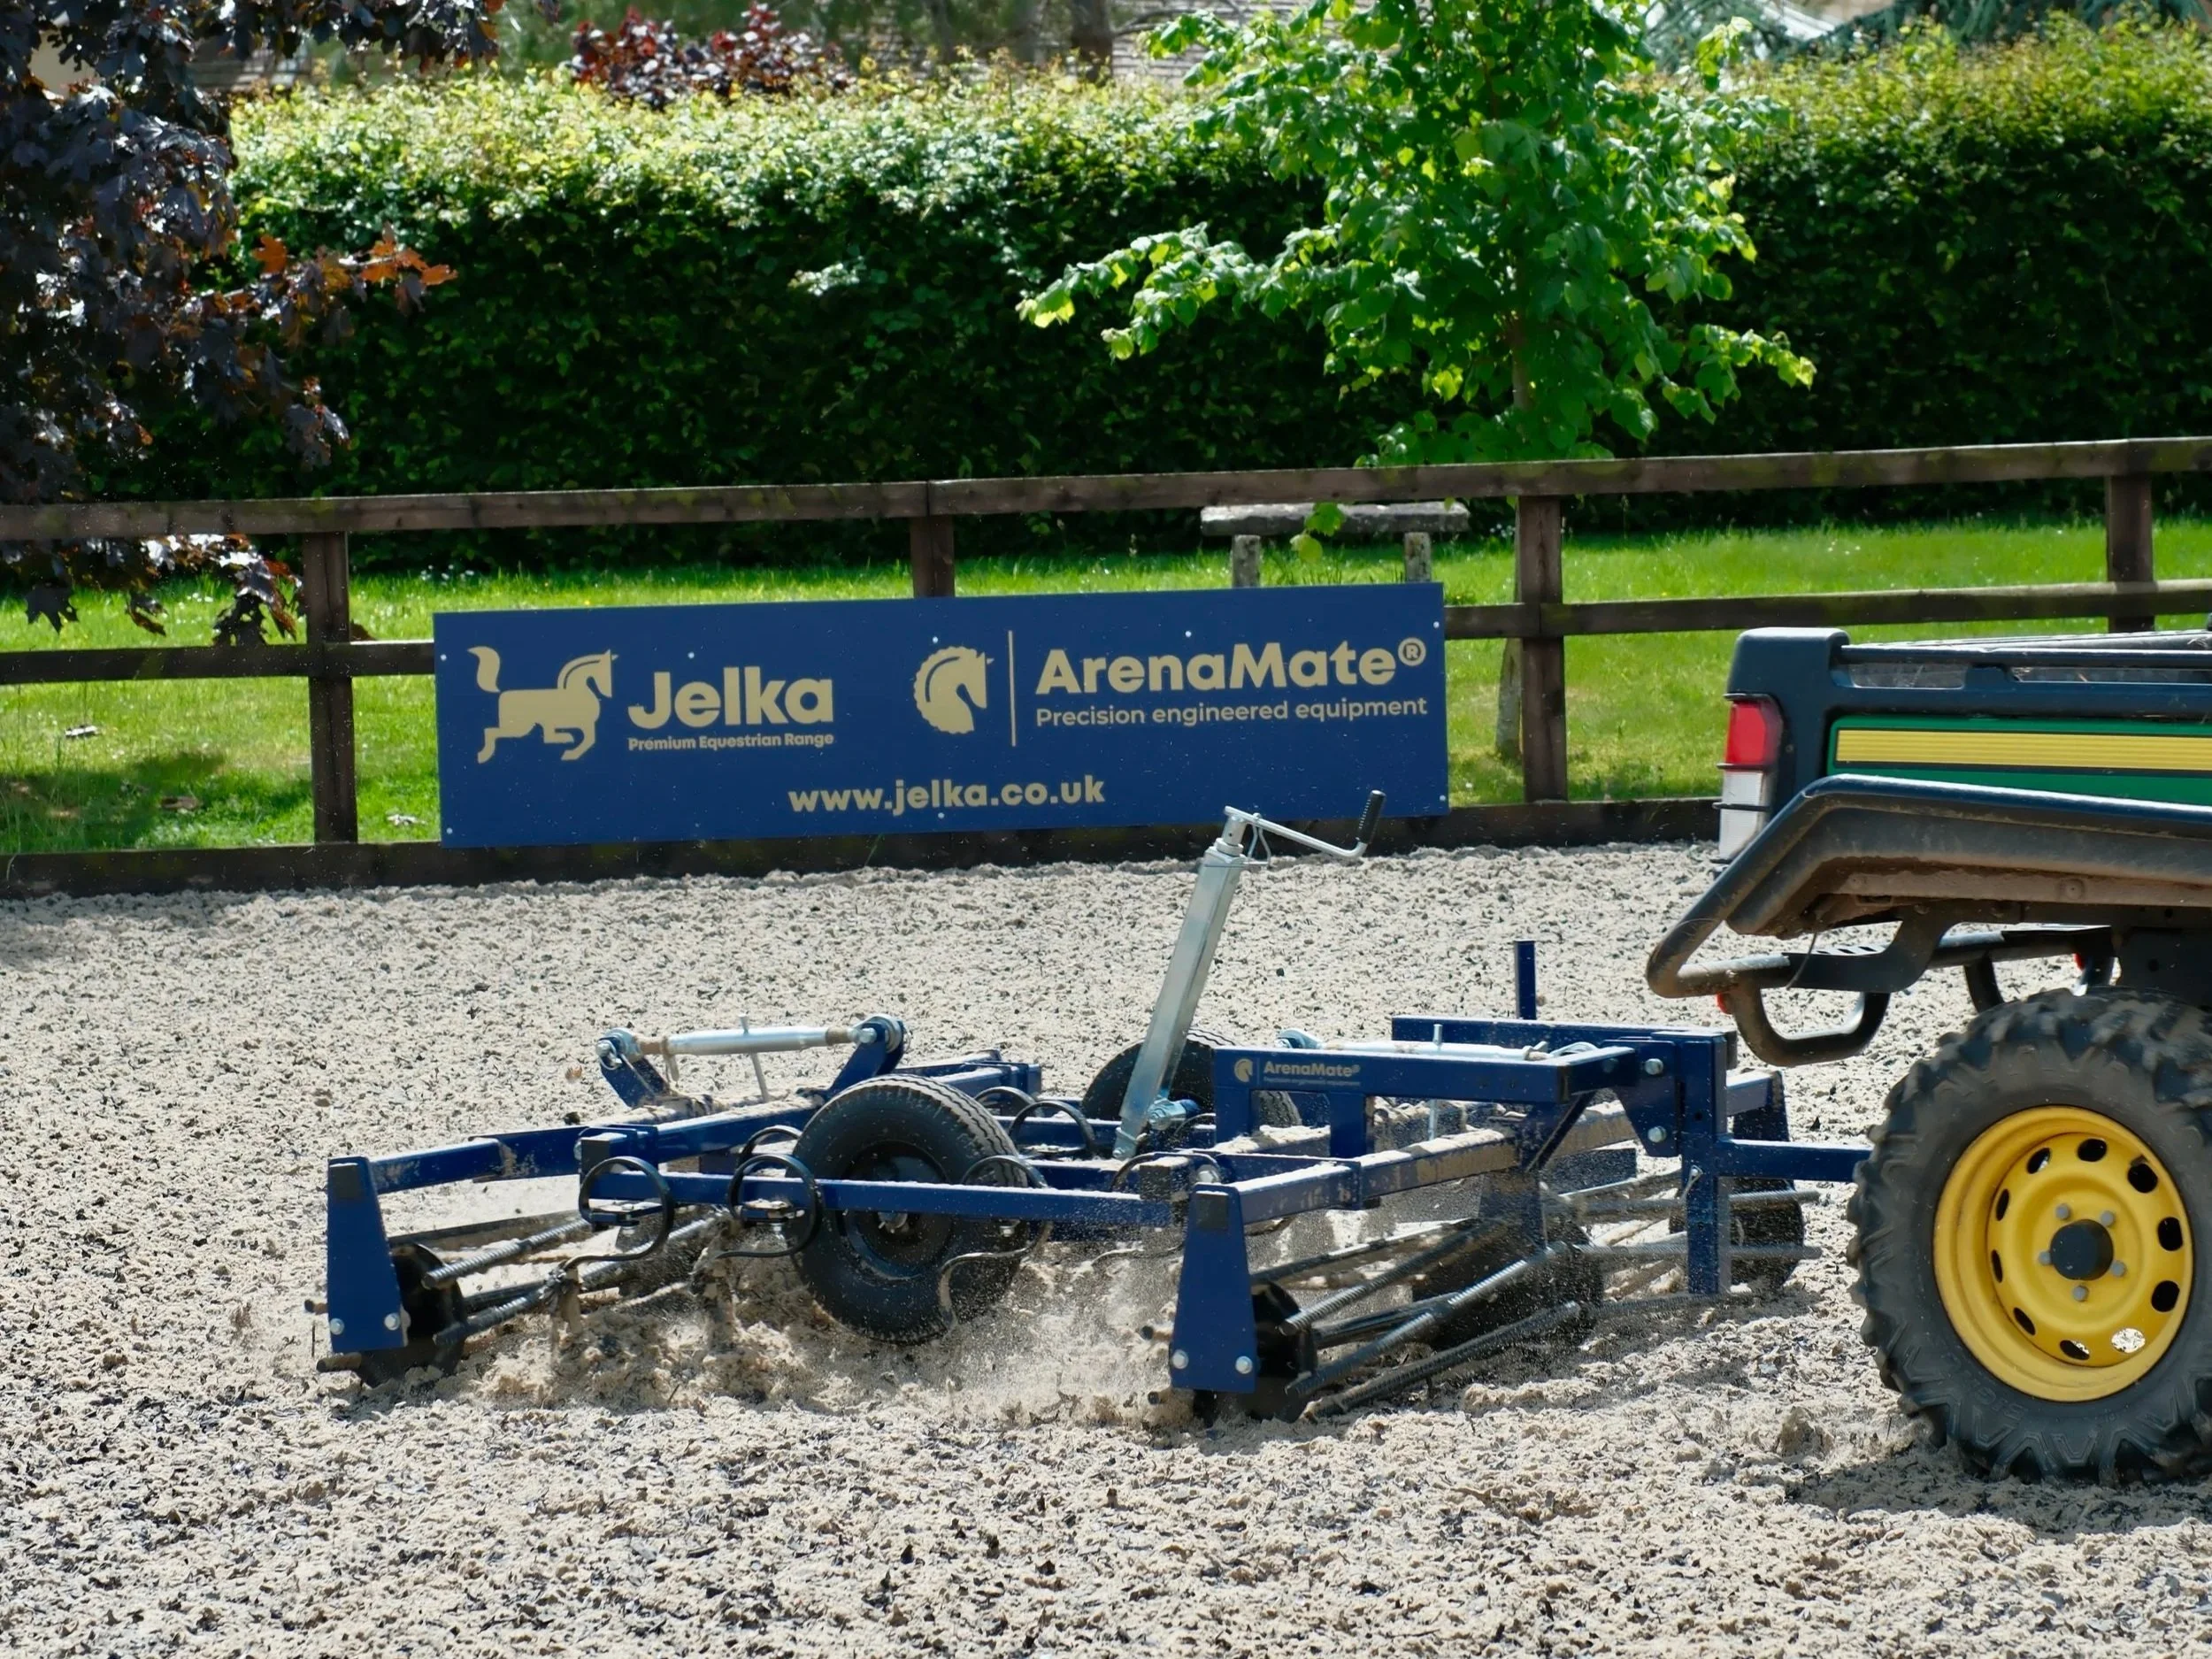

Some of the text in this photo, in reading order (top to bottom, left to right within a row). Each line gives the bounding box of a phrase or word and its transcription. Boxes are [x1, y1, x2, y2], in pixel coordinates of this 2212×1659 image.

[627, 665, 834, 729] Jelka
[1035, 695, 1428, 727] Precision engineered equipment
[627, 731, 834, 751] Premium Equestrian Range
[788, 774, 1105, 817] www.jelka.co.uk
